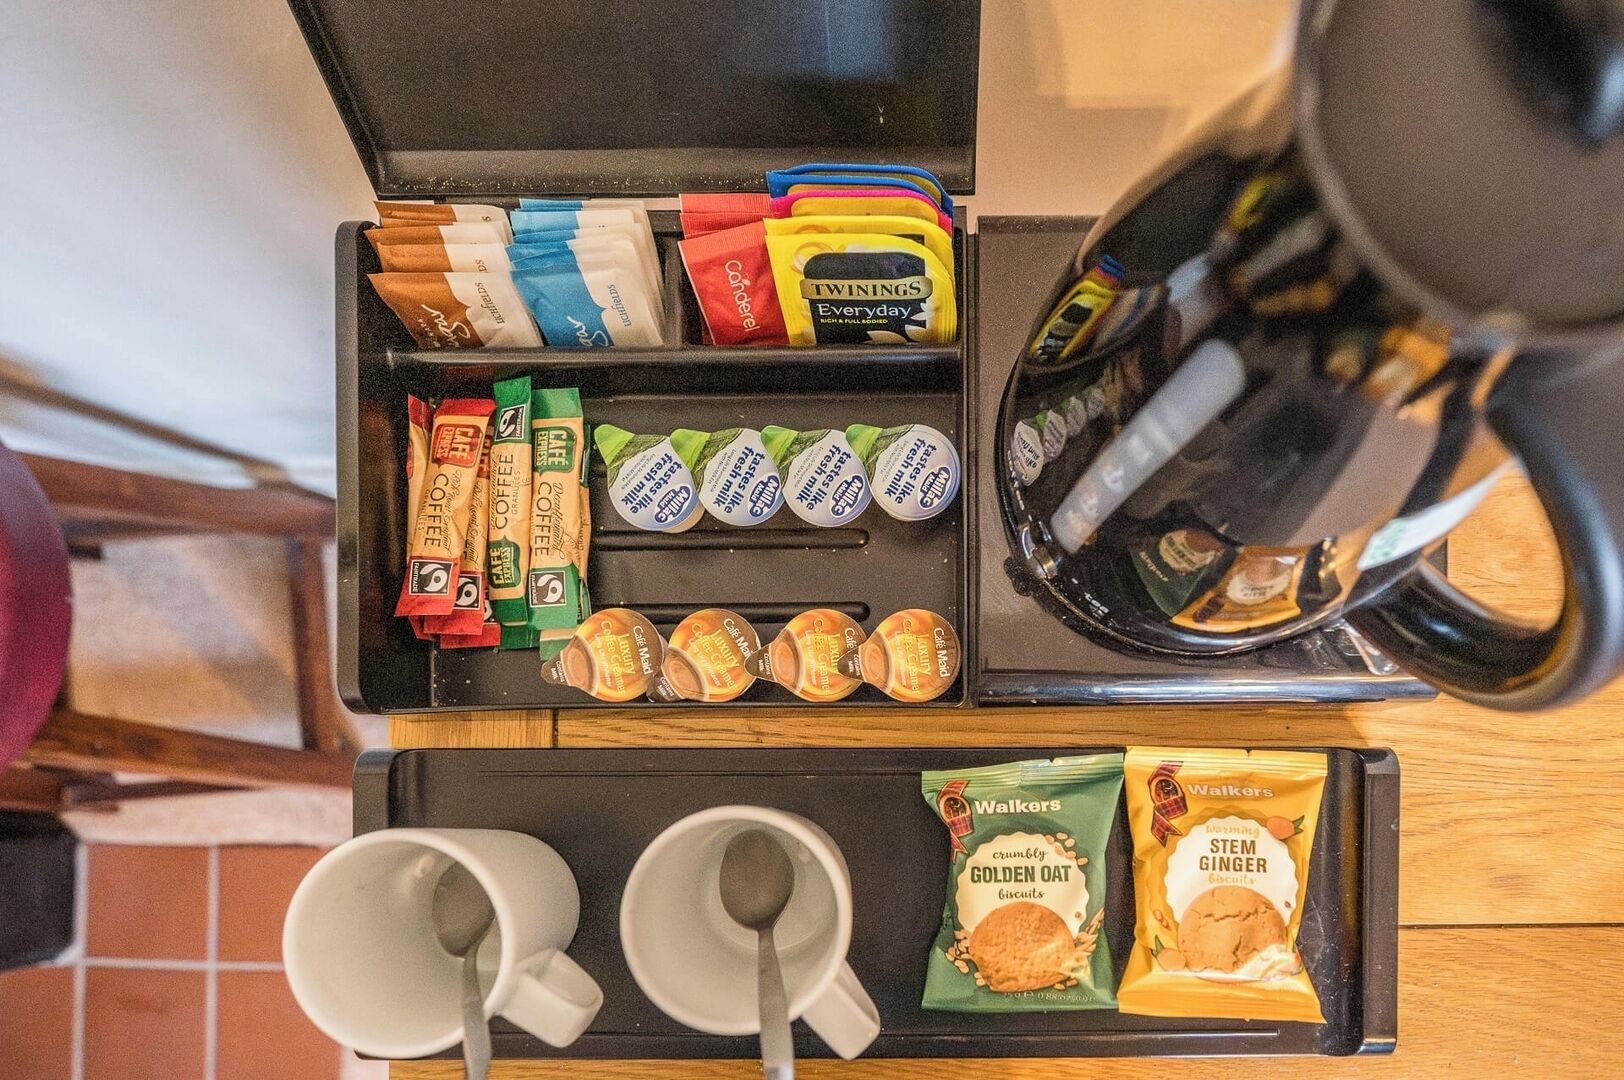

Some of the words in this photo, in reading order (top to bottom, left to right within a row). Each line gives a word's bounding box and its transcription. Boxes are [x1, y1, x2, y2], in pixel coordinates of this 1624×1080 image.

[725, 260, 760, 332] Canderel
[811, 281, 921, 296] TWININGS
[816, 303, 911, 319] Everyday
[436, 426, 453, 457] EXPRESS
[448, 427, 474, 459] CAFÉ
[534, 430, 549, 466] EXPRESS
[546, 429, 571, 466] CAFÉ
[901, 438, 926, 468] fresh
[644, 453, 673, 481] fresh
[730, 446, 754, 478] fresh
[738, 453, 765, 490] tastes
[815, 445, 841, 476] fresh
[822, 452, 851, 488] tastes
[910, 444, 936, 481] tastes
[494, 453, 513, 529] COFFEE
[510, 470, 520, 514] GRANULES
[650, 462, 682, 495] tastes
[752, 482, 764, 500] Maid
[796, 476, 817, 502] milk
[834, 482, 850, 500] Maid
[885, 470, 904, 497] milk
[922, 473, 936, 491] Maid
[922, 468, 950, 507] Millac
[622, 481, 645, 505] milk
[630, 494, 653, 513] like
[656, 486, 690, 521] Millac
[660, 490, 676, 507] Maid
[713, 479, 733, 506] milk
[724, 491, 744, 513] like
[751, 477, 779, 516] Millac
[806, 488, 827, 510] like
[833, 477, 863, 515] Millac
[895, 482, 915, 504] like
[424, 473, 449, 546] COFFEE
[532, 481, 554, 557] COFFEE
[546, 482, 570, 559] Decaffeinated
[500, 547, 512, 582] EXPRESS
[634, 626, 646, 647] Café
[724, 618, 740, 640] Café
[736, 636, 754, 658] Mai
[812, 617, 826, 650] Coffee
[845, 628, 856, 648] Café
[900, 618, 915, 650] Coffee
[934, 628, 946, 649] Café
[600, 619, 617, 653] Coffee
[609, 654, 628, 695] Creamer
[615, 633, 638, 675] Luxury
[639, 650, 653, 674] Maid
[689, 621, 714, 653] Coffee
[709, 651, 739, 691] Creamer
[708, 628, 742, 671] Luxury
[915, 634, 933, 676] Luxury
[555, 660, 564, 682] Contains
[763, 653, 771, 674] Contains
[817, 652, 832, 695] Creamer
[852, 654, 861, 675] Contains
[906, 653, 921, 695] Creamer
[937, 650, 950, 677] Maid
[657, 684, 667, 695] Milk
[658, 676, 675, 696] Contains
[1188, 784, 1274, 798] Walkers
[974, 800, 1061, 814] Walkers
[1206, 826, 1260, 838] warming
[992, 848, 1048, 862] crumbly
[1210, 838, 1256, 855] STEM
[970, 866, 1036, 884] GOLDEN
[1040, 865, 1072, 882] OAT
[1200, 856, 1268, 873] GINGER
[1208, 874, 1254, 884] biscuits
[998, 888, 1045, 900] biscuits
